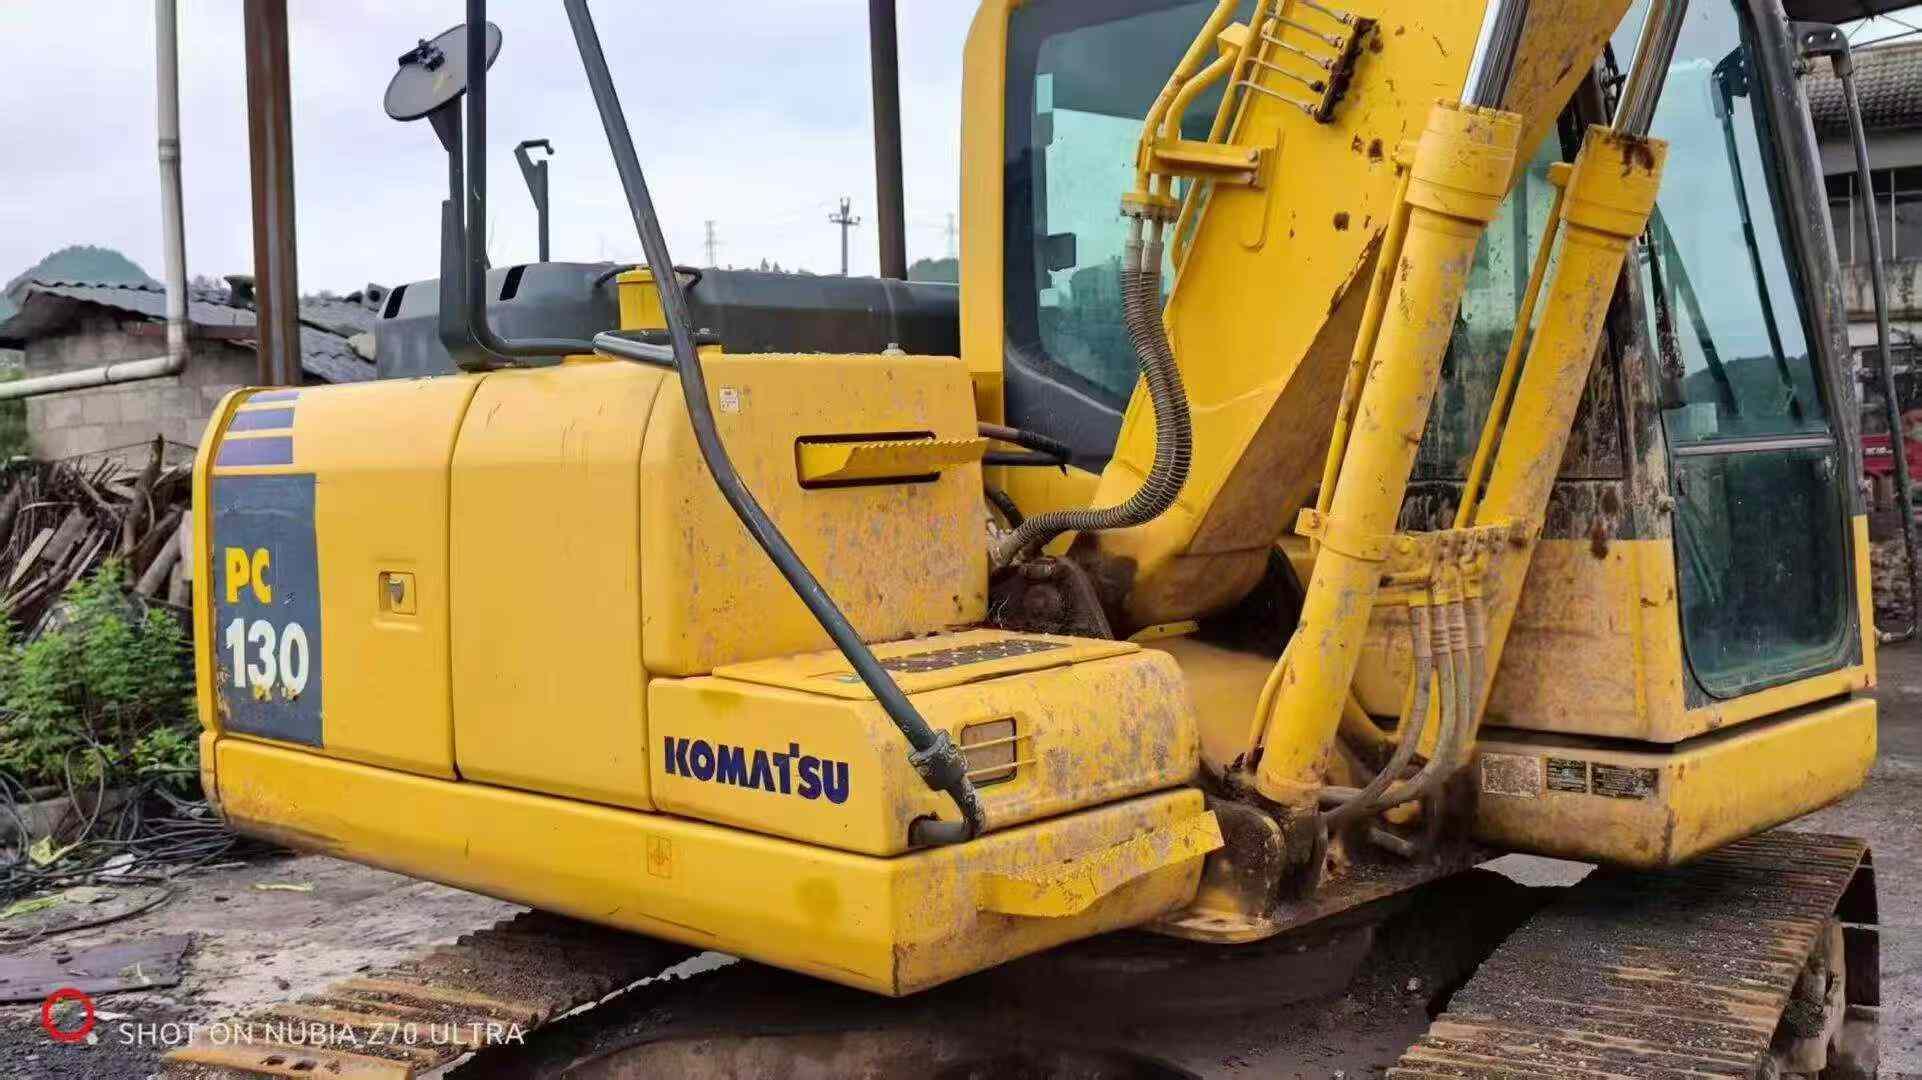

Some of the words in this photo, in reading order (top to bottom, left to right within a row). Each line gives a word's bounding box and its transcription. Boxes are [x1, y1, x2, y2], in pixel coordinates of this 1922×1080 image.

[225, 547, 272, 604] PC
[225, 617, 309, 701] 130
[664, 735, 850, 805] KOMATSU
